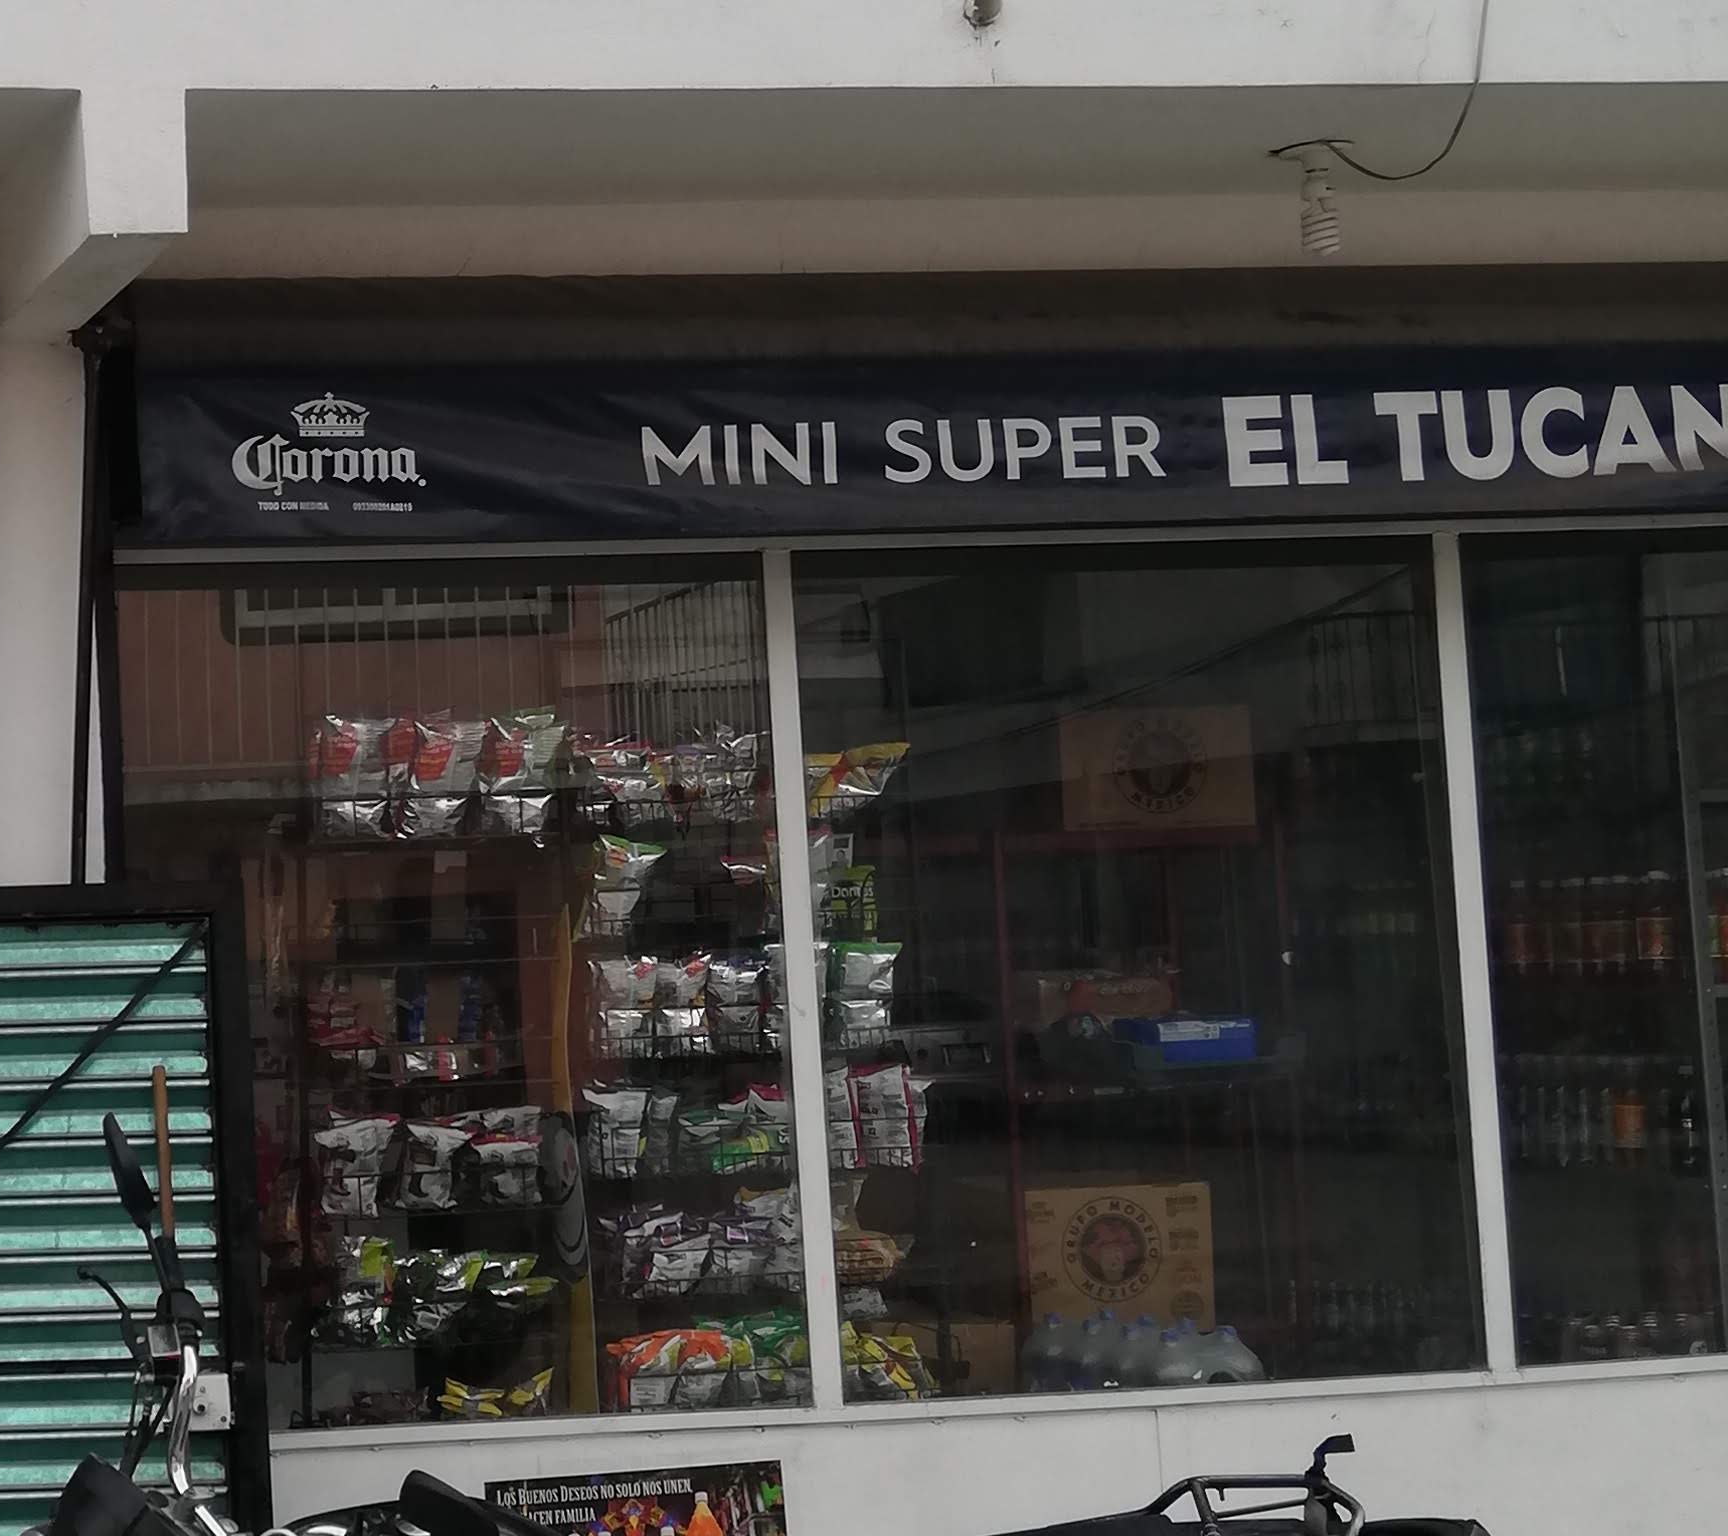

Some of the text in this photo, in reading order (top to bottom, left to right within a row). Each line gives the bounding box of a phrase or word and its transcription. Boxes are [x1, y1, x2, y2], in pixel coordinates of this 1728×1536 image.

[641, 383, 1728, 488] MINI SUPER EL TUCAN
[231, 433, 422, 496] Corona
[560, 1485, 599, 1503] DESEOS
[600, 1484, 615, 1500] NO
[642, 1480, 663, 1496] NOS
[554, 1507, 597, 1524] FAMILIA
